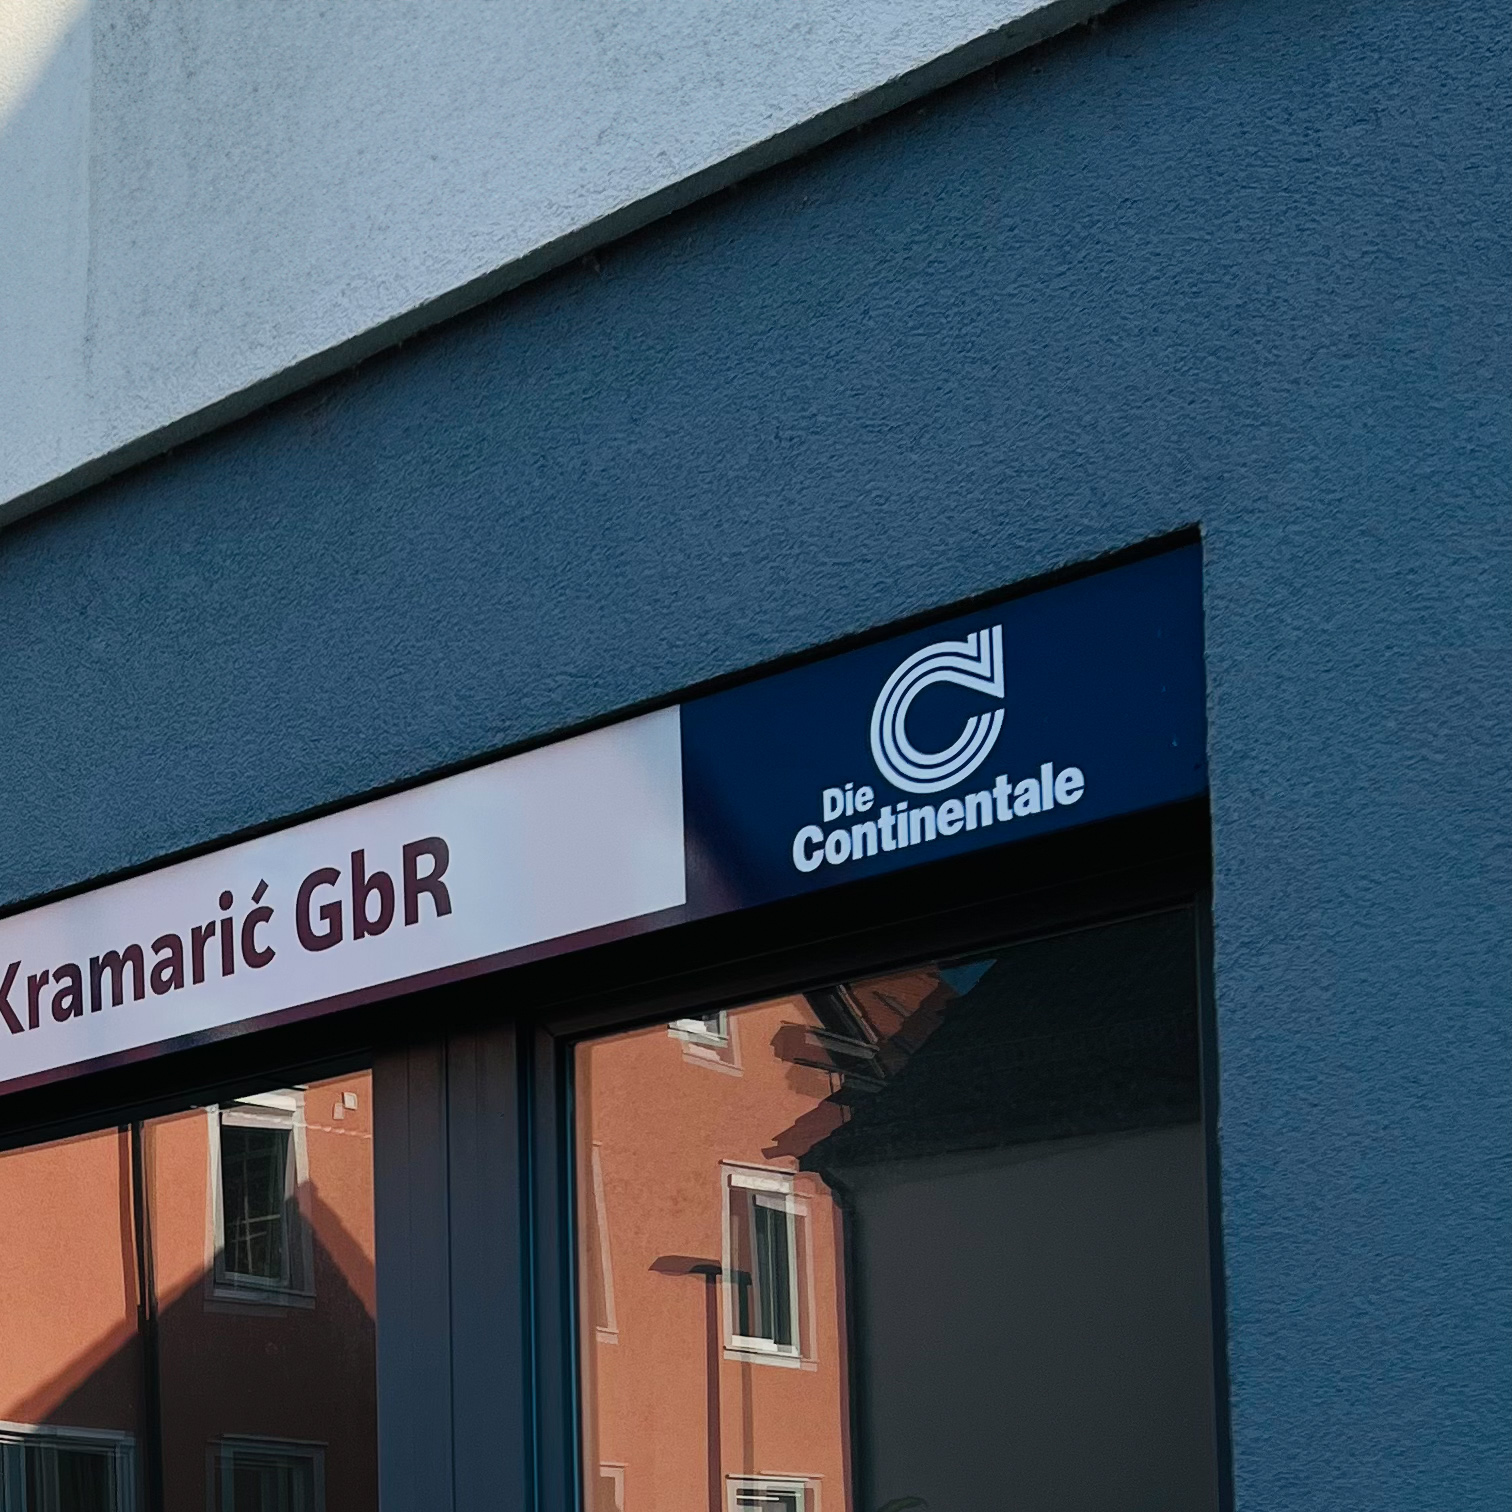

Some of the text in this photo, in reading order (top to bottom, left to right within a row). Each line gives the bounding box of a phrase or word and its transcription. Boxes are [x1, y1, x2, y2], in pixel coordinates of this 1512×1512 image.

[792, 762, 1085, 873] Continentale
[822, 782, 875, 822] Die
[296, 836, 453, 953] GbR
